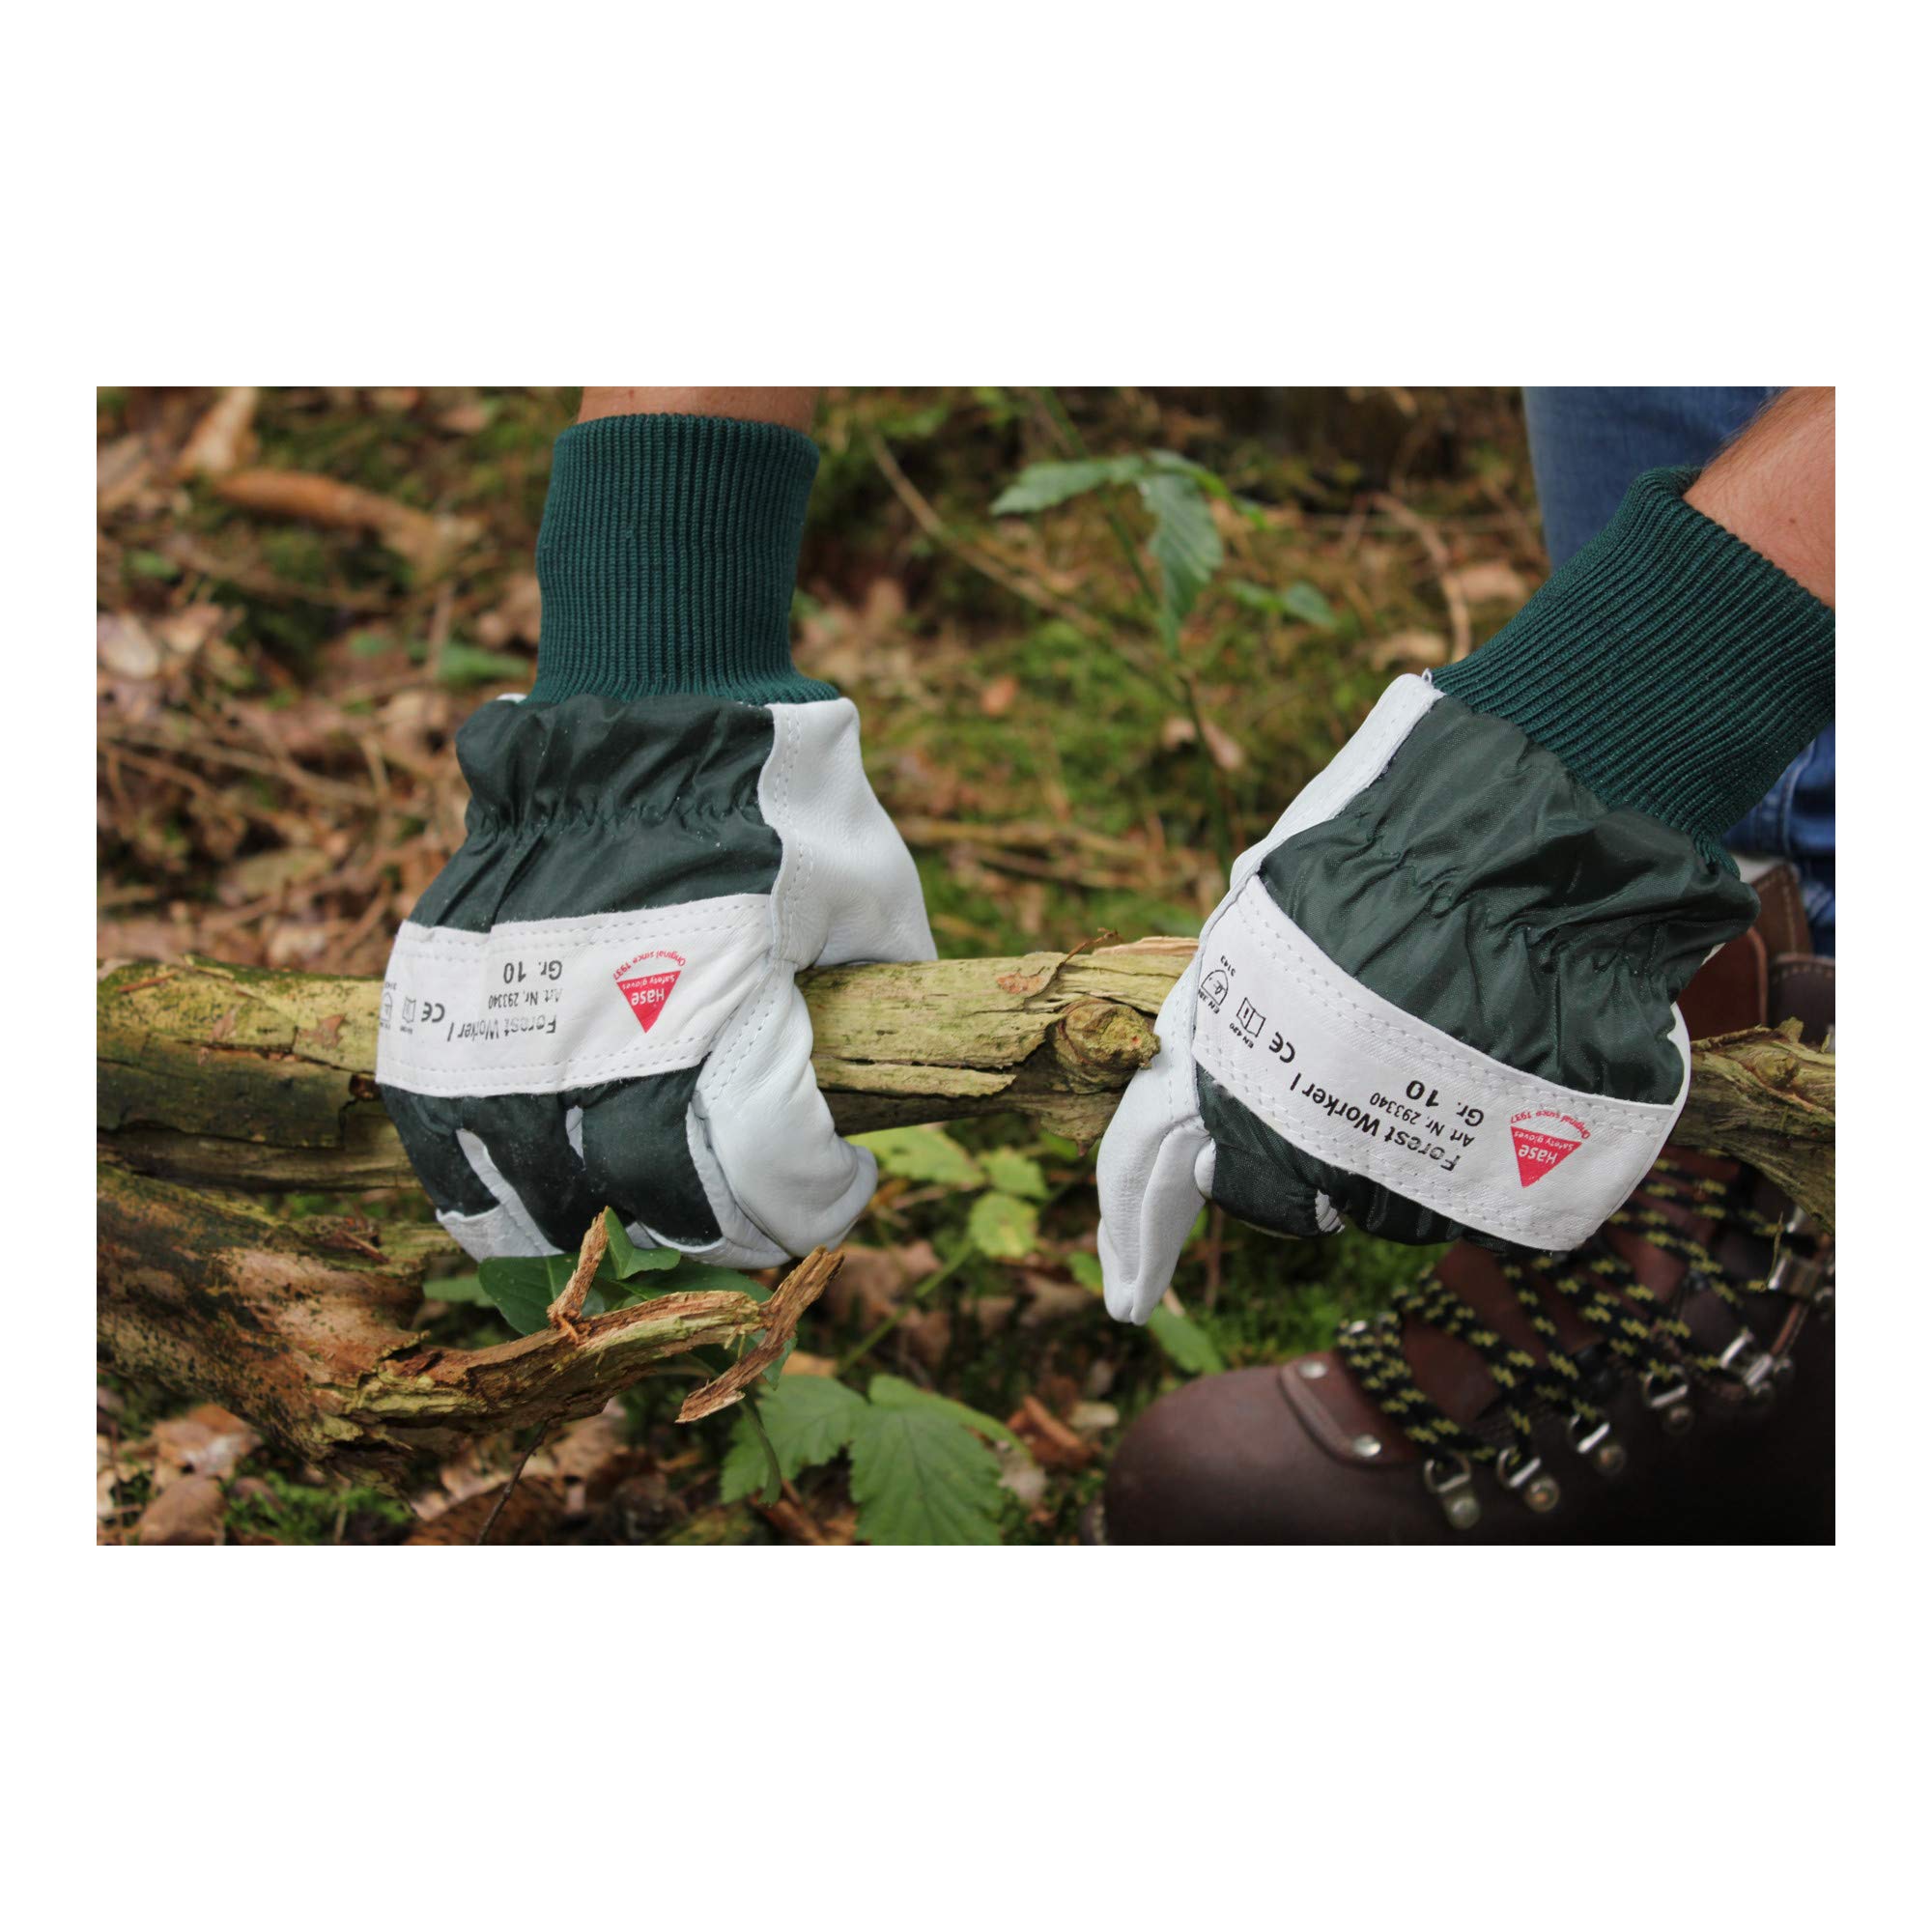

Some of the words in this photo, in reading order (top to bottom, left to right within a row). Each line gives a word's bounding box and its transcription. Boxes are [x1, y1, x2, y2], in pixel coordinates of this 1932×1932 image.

[632, 951, 656, 964] since
[656, 950, 687, 967] Original
[503, 960, 527, 984] 10
[537, 959, 563, 981] Gr.
[612, 961, 633, 981] 1937
[648, 974, 676, 985] Safety
[621, 977, 649, 991] gloves
[487, 991, 520, 1010] 293340
[457, 1018, 500, 1041] Worker
[502, 1014, 557, 1037] Forest
[1242, 1035, 1255, 1049] EN
[1405, 1079, 1440, 1108] 10
[1301, 1083, 1381, 1137] Worker
[1368, 1092, 1423, 1126] 293340
[1455, 1100, 1486, 1128] Gr.
[1510, 1110, 1532, 1124] 1937
[1535, 1109, 1561, 1120] since
[1560, 1114, 1592, 1140] Original
[1513, 1130, 1545, 1146] gloves
[1545, 1137, 1576, 1151] Safety
[1383, 1125, 1462, 1172] Forest
